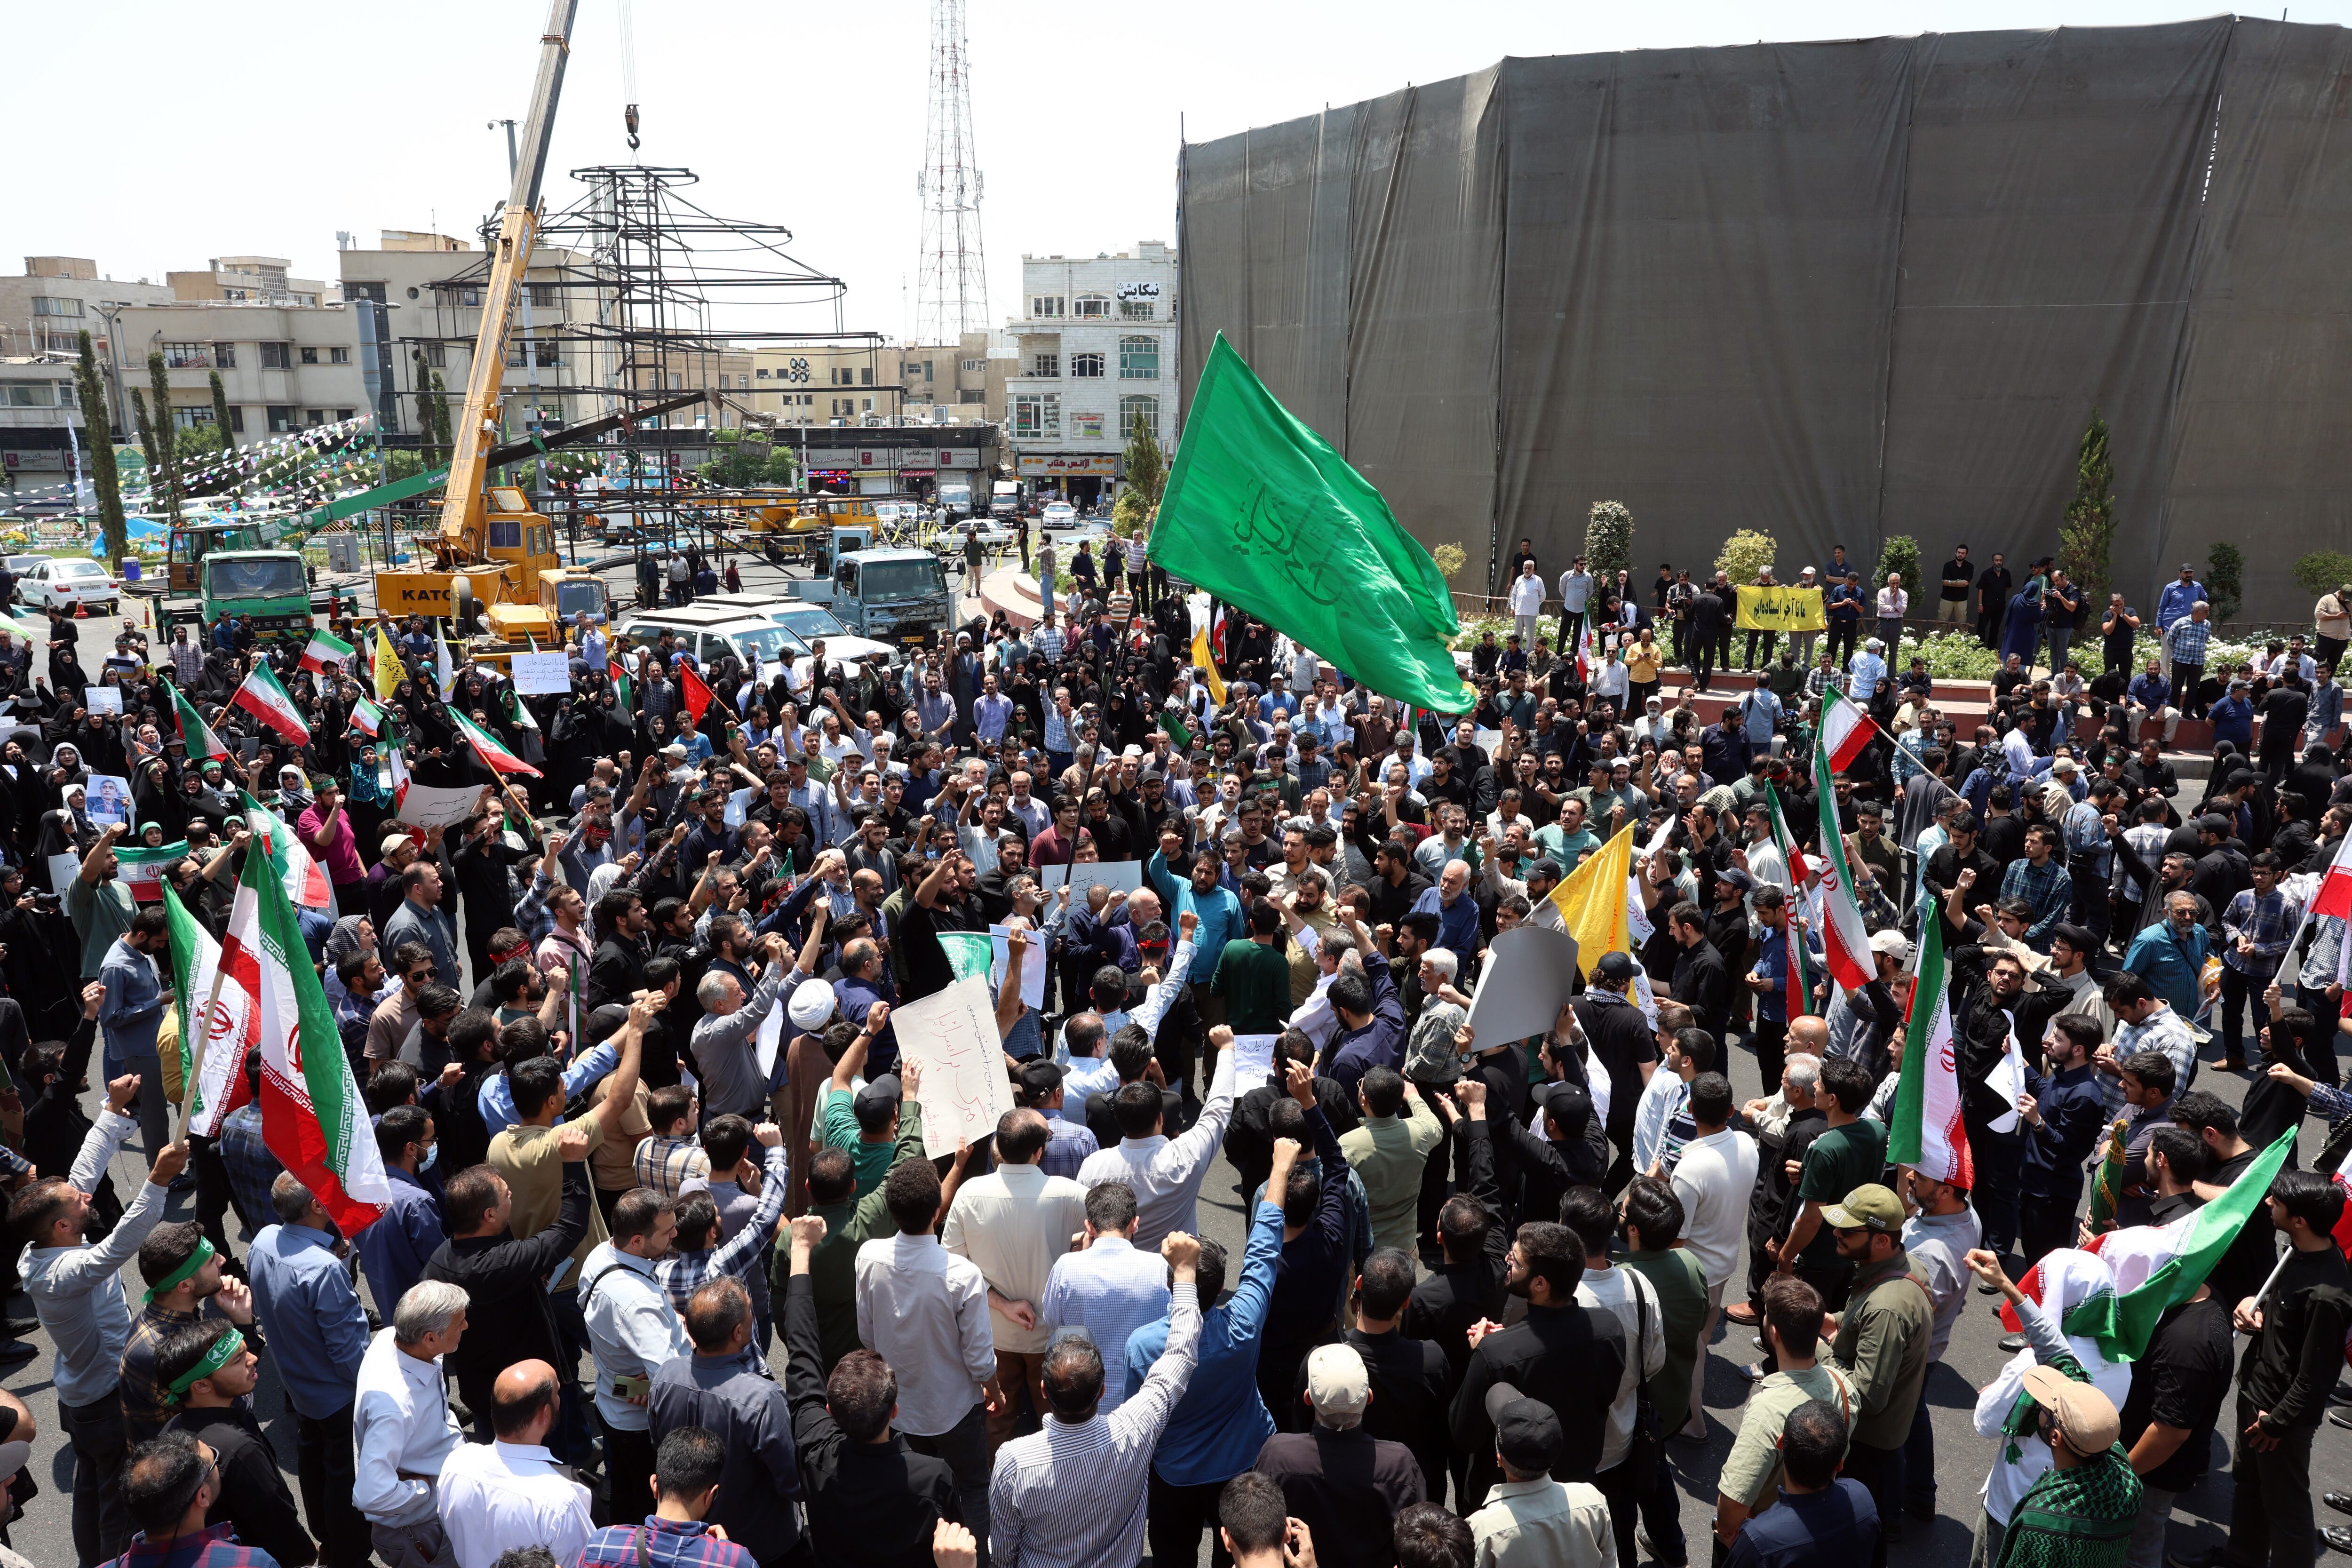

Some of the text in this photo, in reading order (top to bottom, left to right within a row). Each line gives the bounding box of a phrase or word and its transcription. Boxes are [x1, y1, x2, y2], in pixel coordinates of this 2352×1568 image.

[519, 225, 529, 260] KATO
[1117, 283, 1159, 300] نیکایش
[1047, 459, 1065, 468] کتاب
[1067, 458, 1090, 469] آژانس
[402, 589, 451, 601] KATO
[1783, 597, 1795, 622] آخر
[1795, 600, 1800, 618] تا
[1800, 600, 1806, 618] ما
[549, 674, 567, 683] مشترک
[429, 793, 467, 807] خیبر
[420, 803, 465, 818] خیبر
[919, 1003, 971, 1057] اسرائیل
[933, 1057, 961, 1072] بر
[952, 1071, 990, 1128] مرگ
